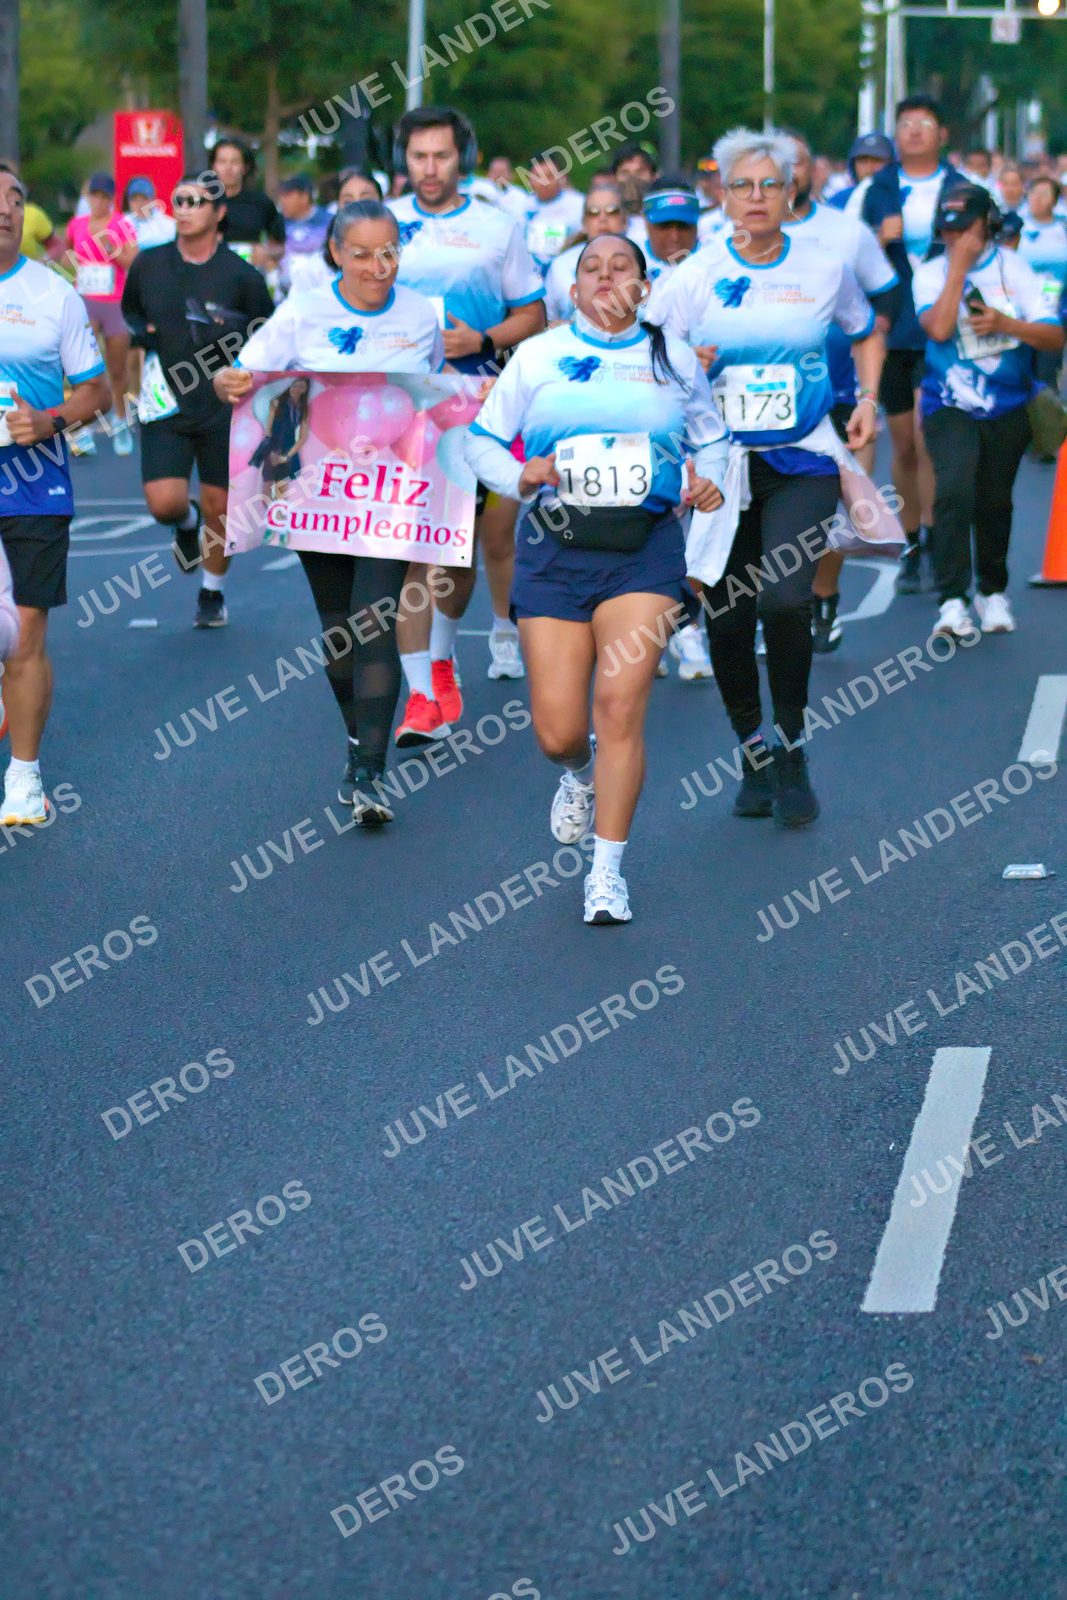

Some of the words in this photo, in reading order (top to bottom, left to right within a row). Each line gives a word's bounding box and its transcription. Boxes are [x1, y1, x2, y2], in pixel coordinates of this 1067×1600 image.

[717, 393, 792, 422] 1173
[318, 462, 430, 507] Feliz
[562, 464, 648, 497] 1813
[266, 503, 468, 547] Cumpleaños
